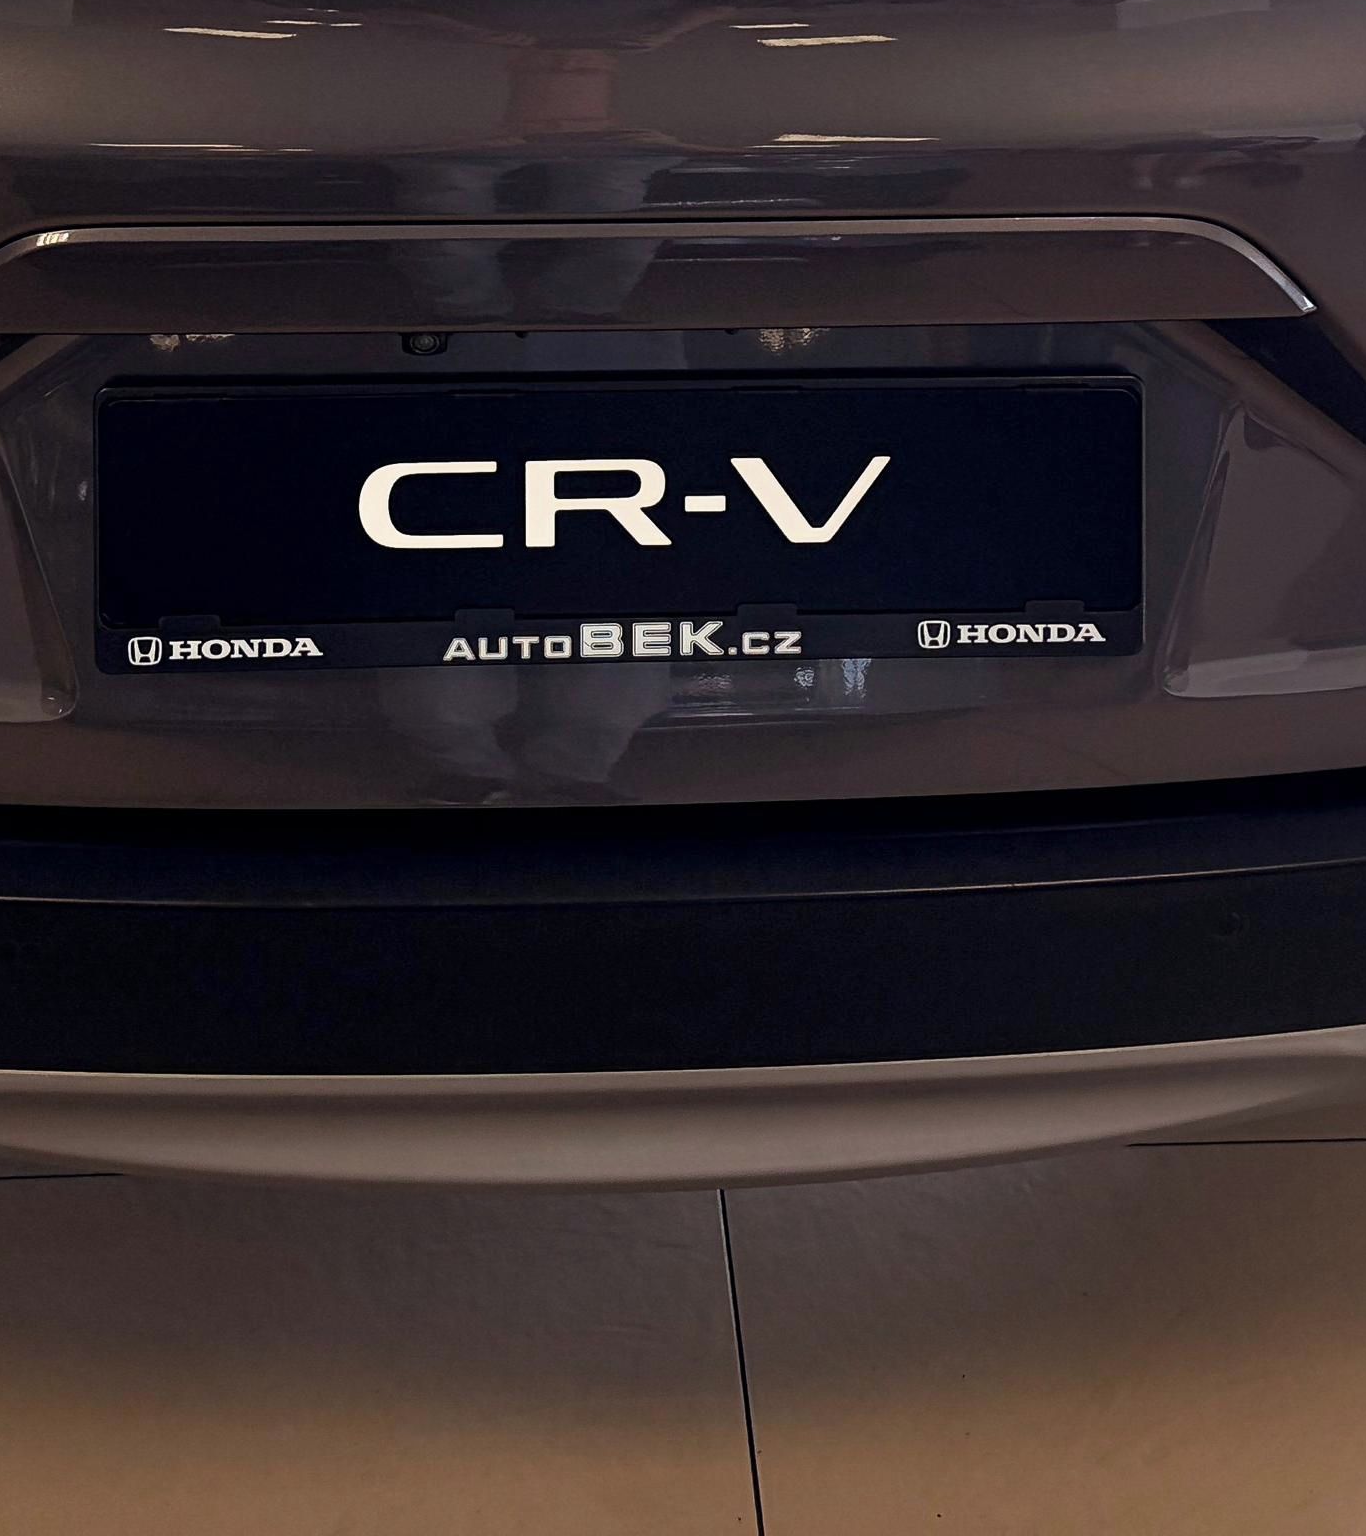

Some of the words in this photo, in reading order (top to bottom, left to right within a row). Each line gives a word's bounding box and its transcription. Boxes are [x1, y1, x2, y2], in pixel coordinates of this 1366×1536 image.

[358, 456, 891, 548] CR-V
[956, 623, 1107, 644] HONDA
[169, 638, 324, 660] HONDA
